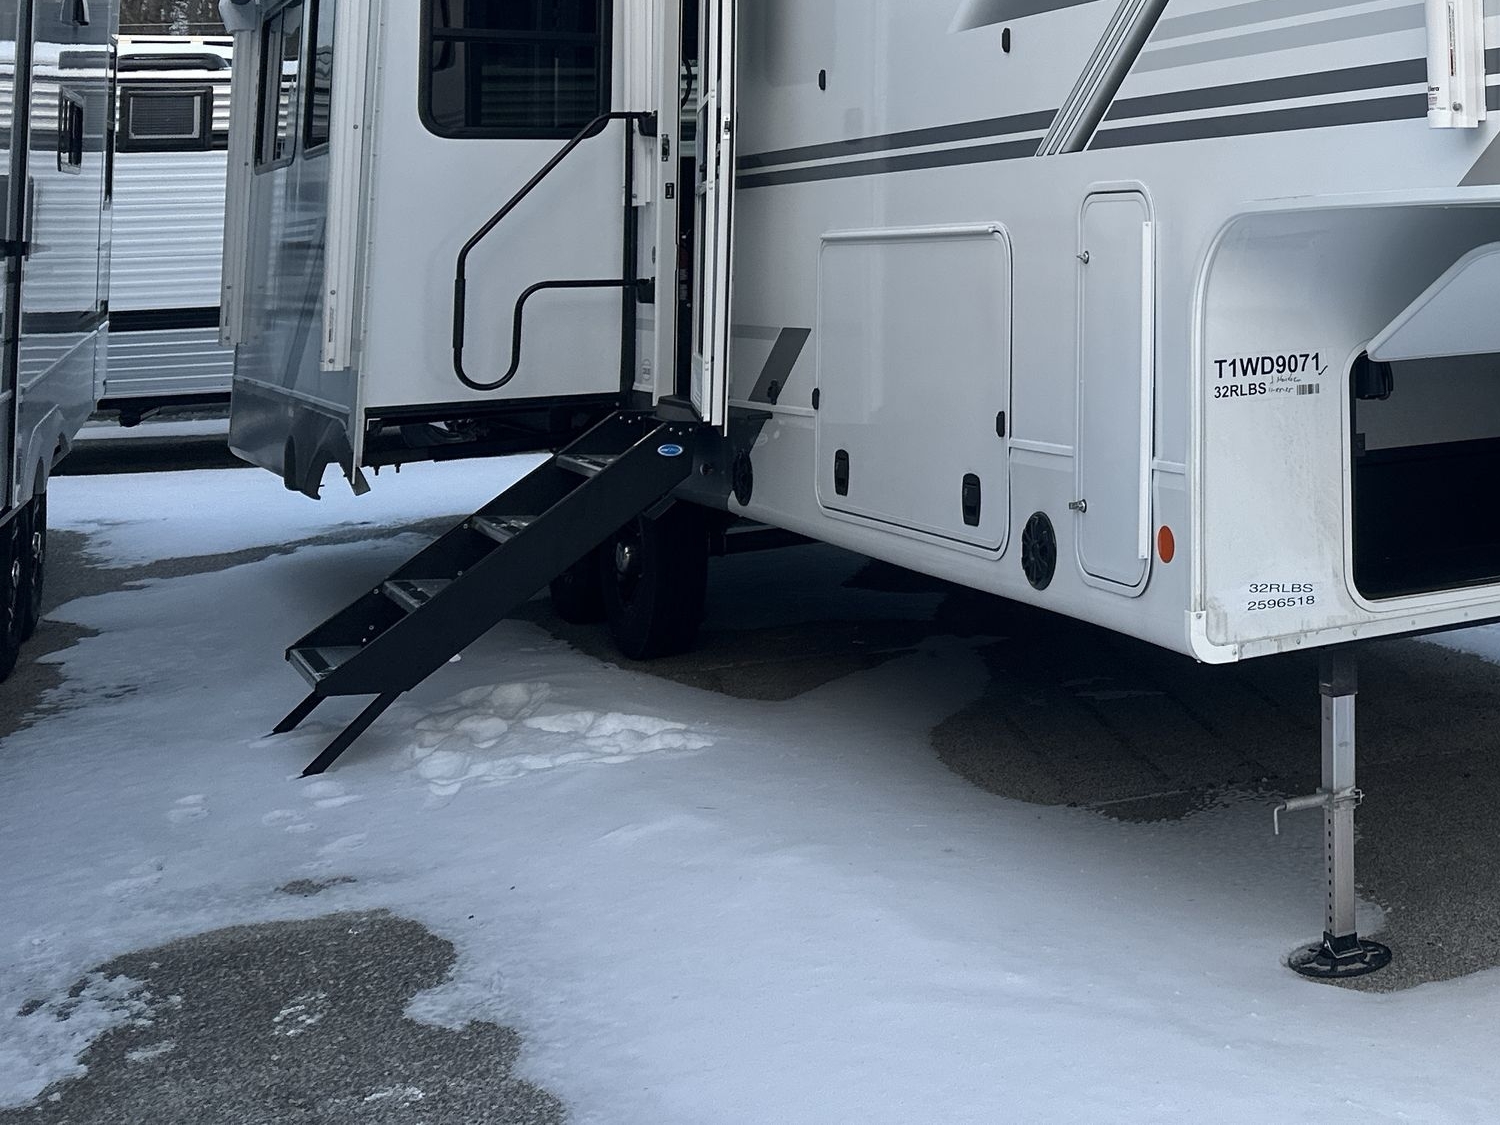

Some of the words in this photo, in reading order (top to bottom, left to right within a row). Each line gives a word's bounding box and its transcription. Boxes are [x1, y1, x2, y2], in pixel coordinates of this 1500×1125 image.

[1213, 352, 1320, 379] T1WD9071
[1213, 382, 1267, 399] 32RLBS
[1248, 583, 1314, 594] 32RLBS
[1247, 595, 1315, 611] 2596518
